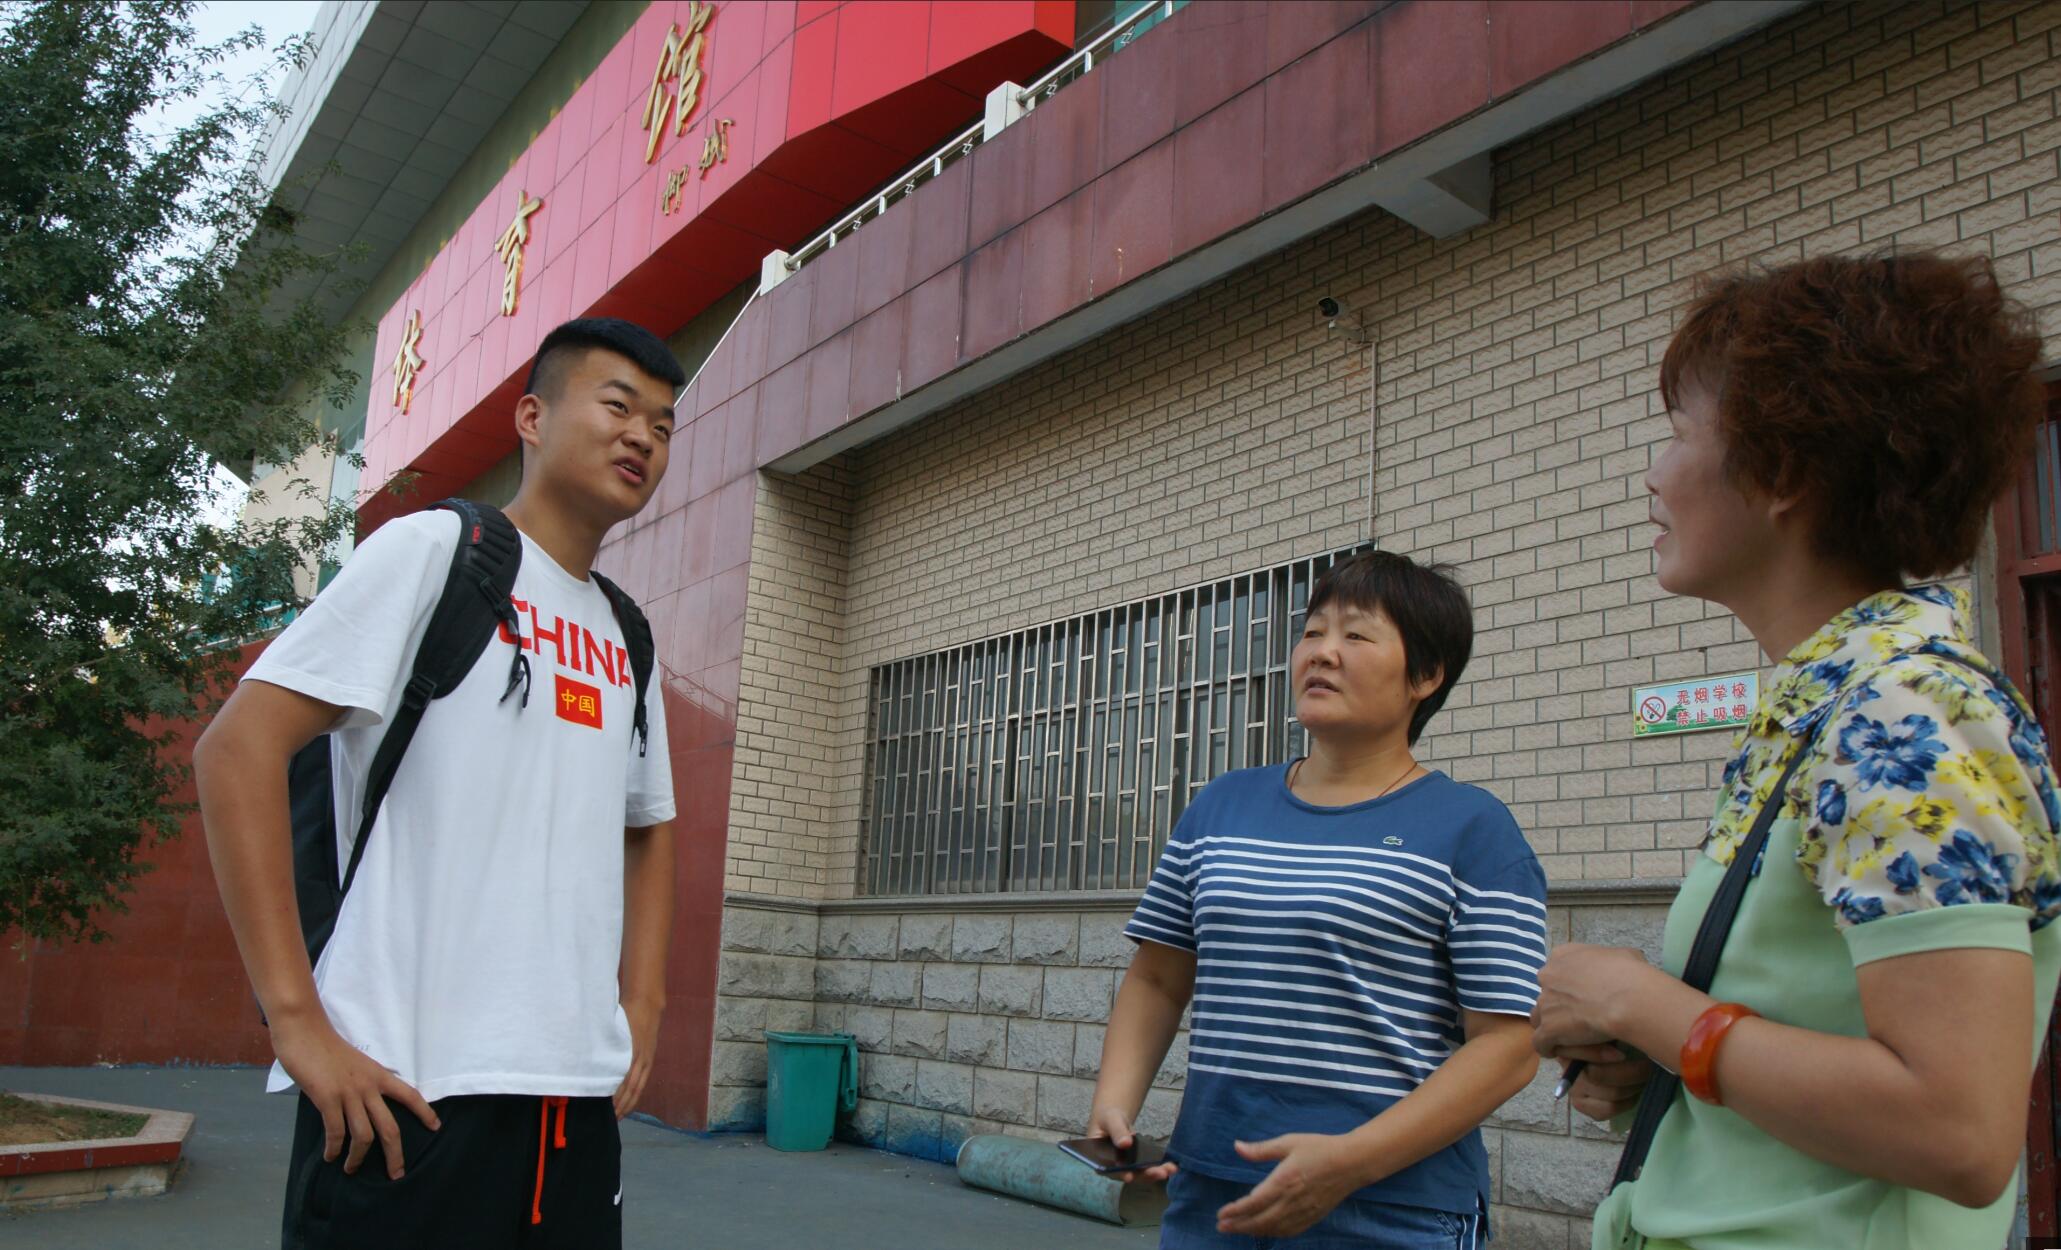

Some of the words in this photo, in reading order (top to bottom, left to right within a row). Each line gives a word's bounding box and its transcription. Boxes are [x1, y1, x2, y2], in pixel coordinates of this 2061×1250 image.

[561, 688, 596, 718] 中国
[1676, 682, 1747, 706] 无烟学校
[1676, 704, 1747, 727] 禁止吸烟
